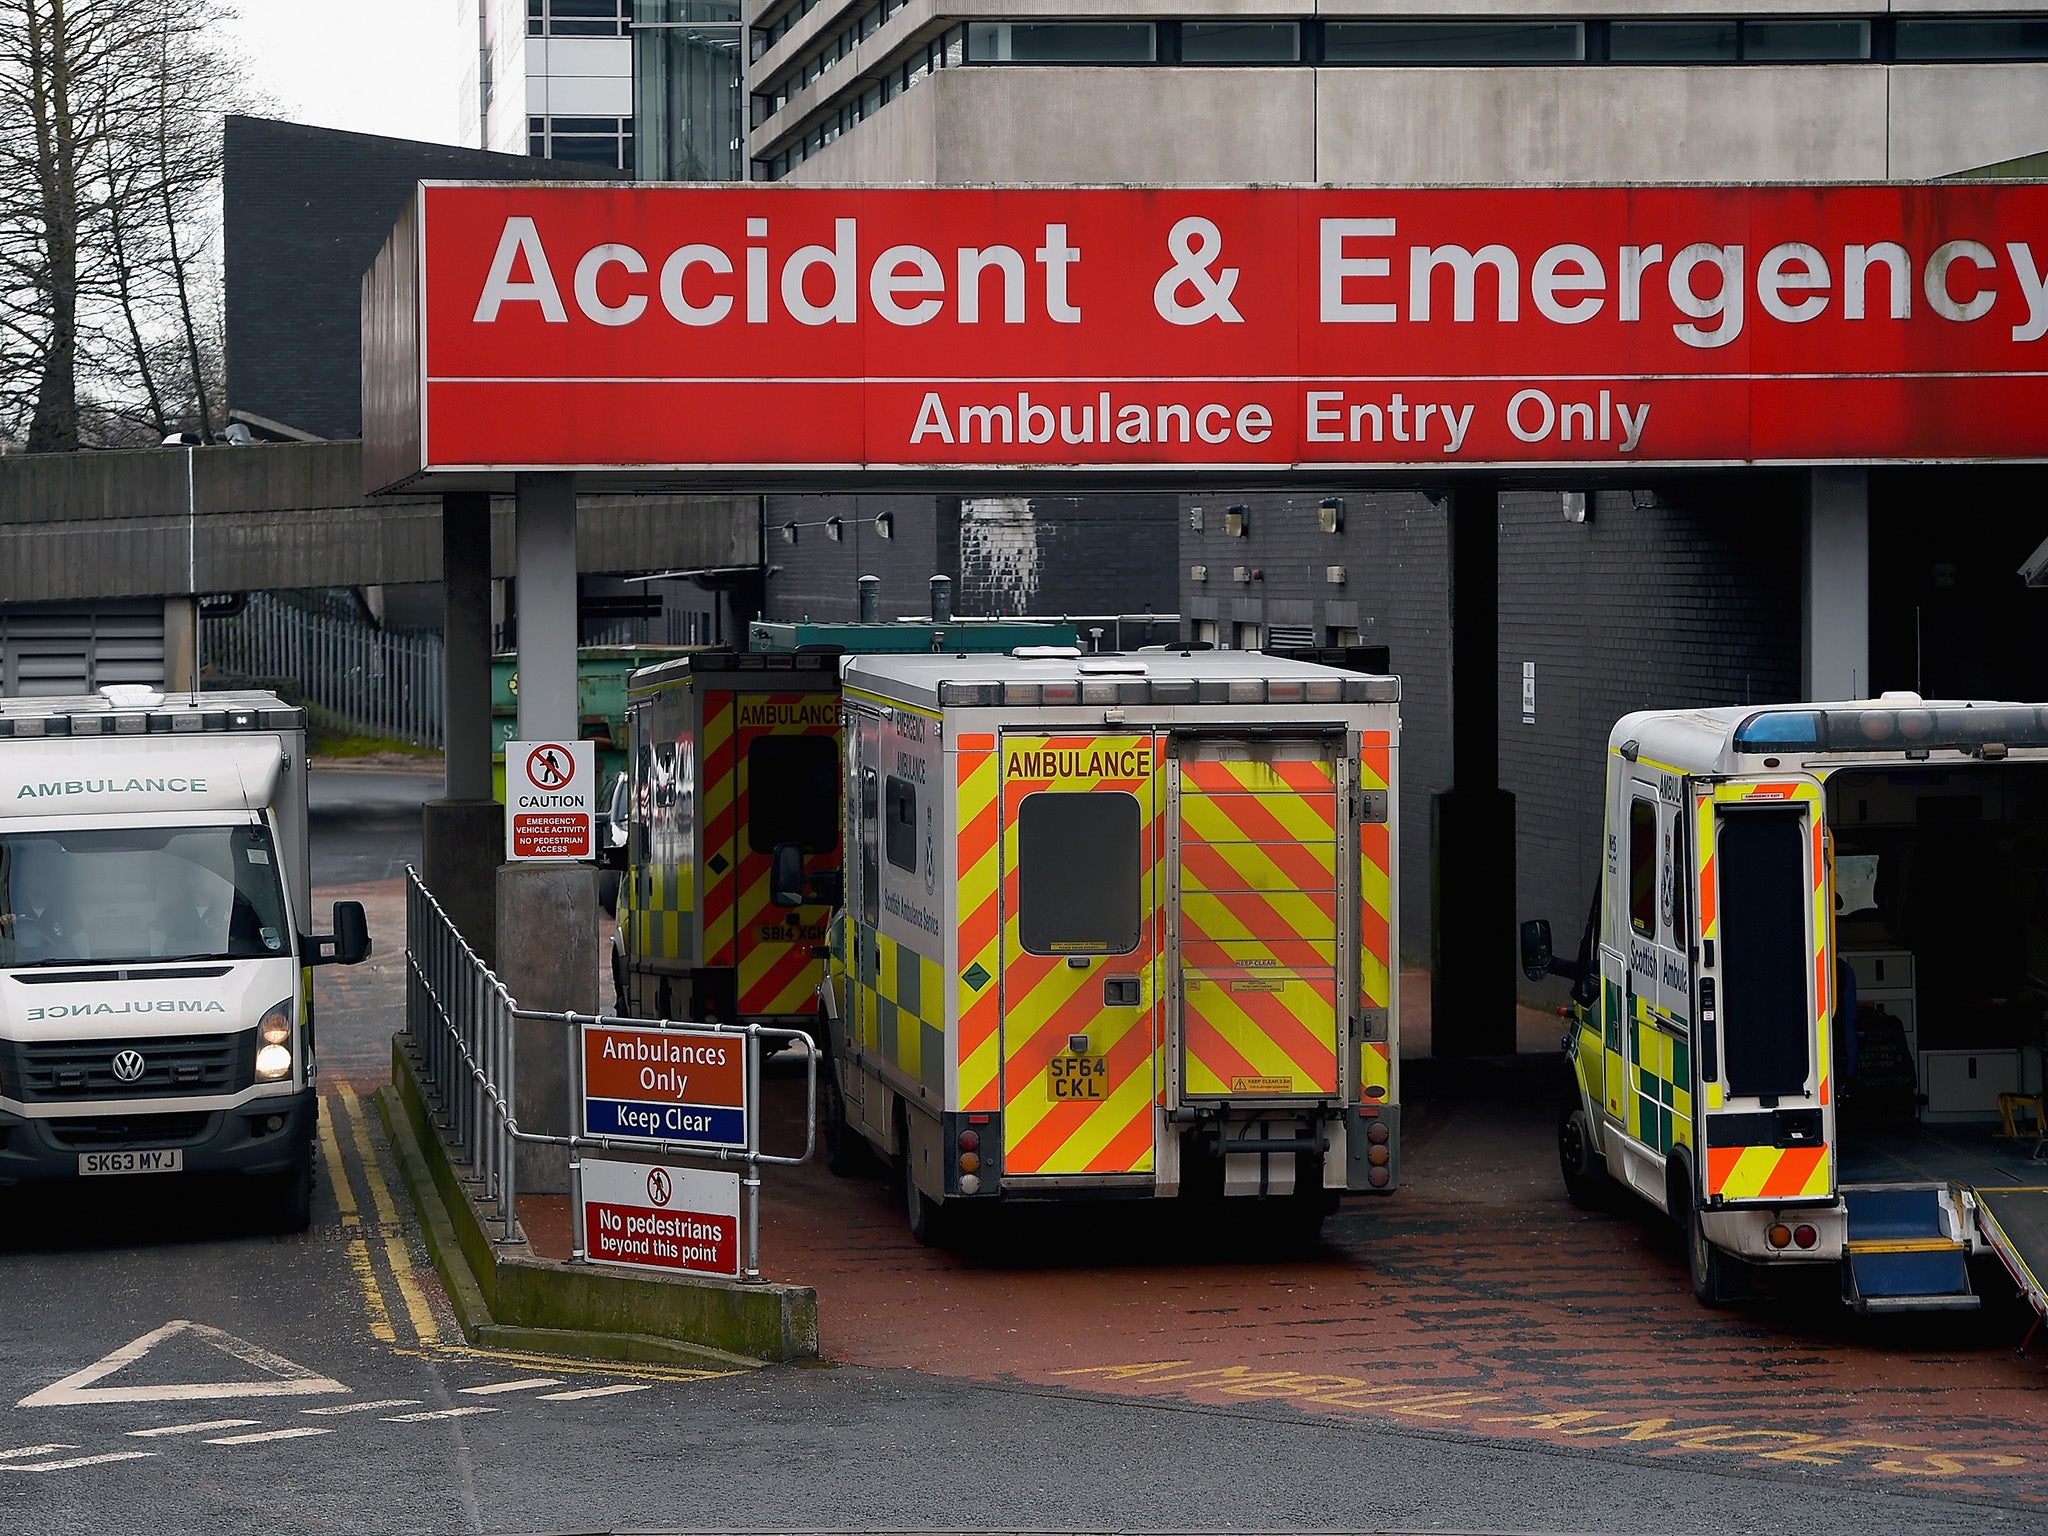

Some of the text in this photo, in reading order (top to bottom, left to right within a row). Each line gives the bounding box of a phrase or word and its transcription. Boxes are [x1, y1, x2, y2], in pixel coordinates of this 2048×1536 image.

[472, 217, 1081, 327] Accident
[1153, 216, 1245, 326] &
[909, 388, 1651, 453] Ambulance Entry Only
[897, 711, 925, 745] EMERGENCY
[897, 751, 925, 785] AMBULANCE
[1007, 751, 1150, 777] AMBULANCE
[17, 778, 208, 799] AMBULANCE
[519, 795, 584, 808] CAUTION
[516, 825, 587, 834] VEHICLE ACTIVITY
[526, 817, 576, 825] EMERGENCY
[535, 845, 568, 853] ACCESS
[884, 887, 939, 937] Scottish Ambulance Service
[762, 926, 793, 940] SB14
[1630, 938, 1658, 981] Scottish
[602, 1036, 726, 1066] Ambulances
[1051, 1058, 1105, 1077] SF64
[640, 1066, 688, 1099] Only
[1055, 1078, 1100, 1097] CKL
[617, 1105, 712, 1134] Keep Clear
[87, 1152, 175, 1172] SK63 MYJ
[600, 1208, 722, 1242] No pedestrians
[600, 1232, 717, 1264] beyond this point
[1049, 1360, 2027, 1476] AMBULANCES
